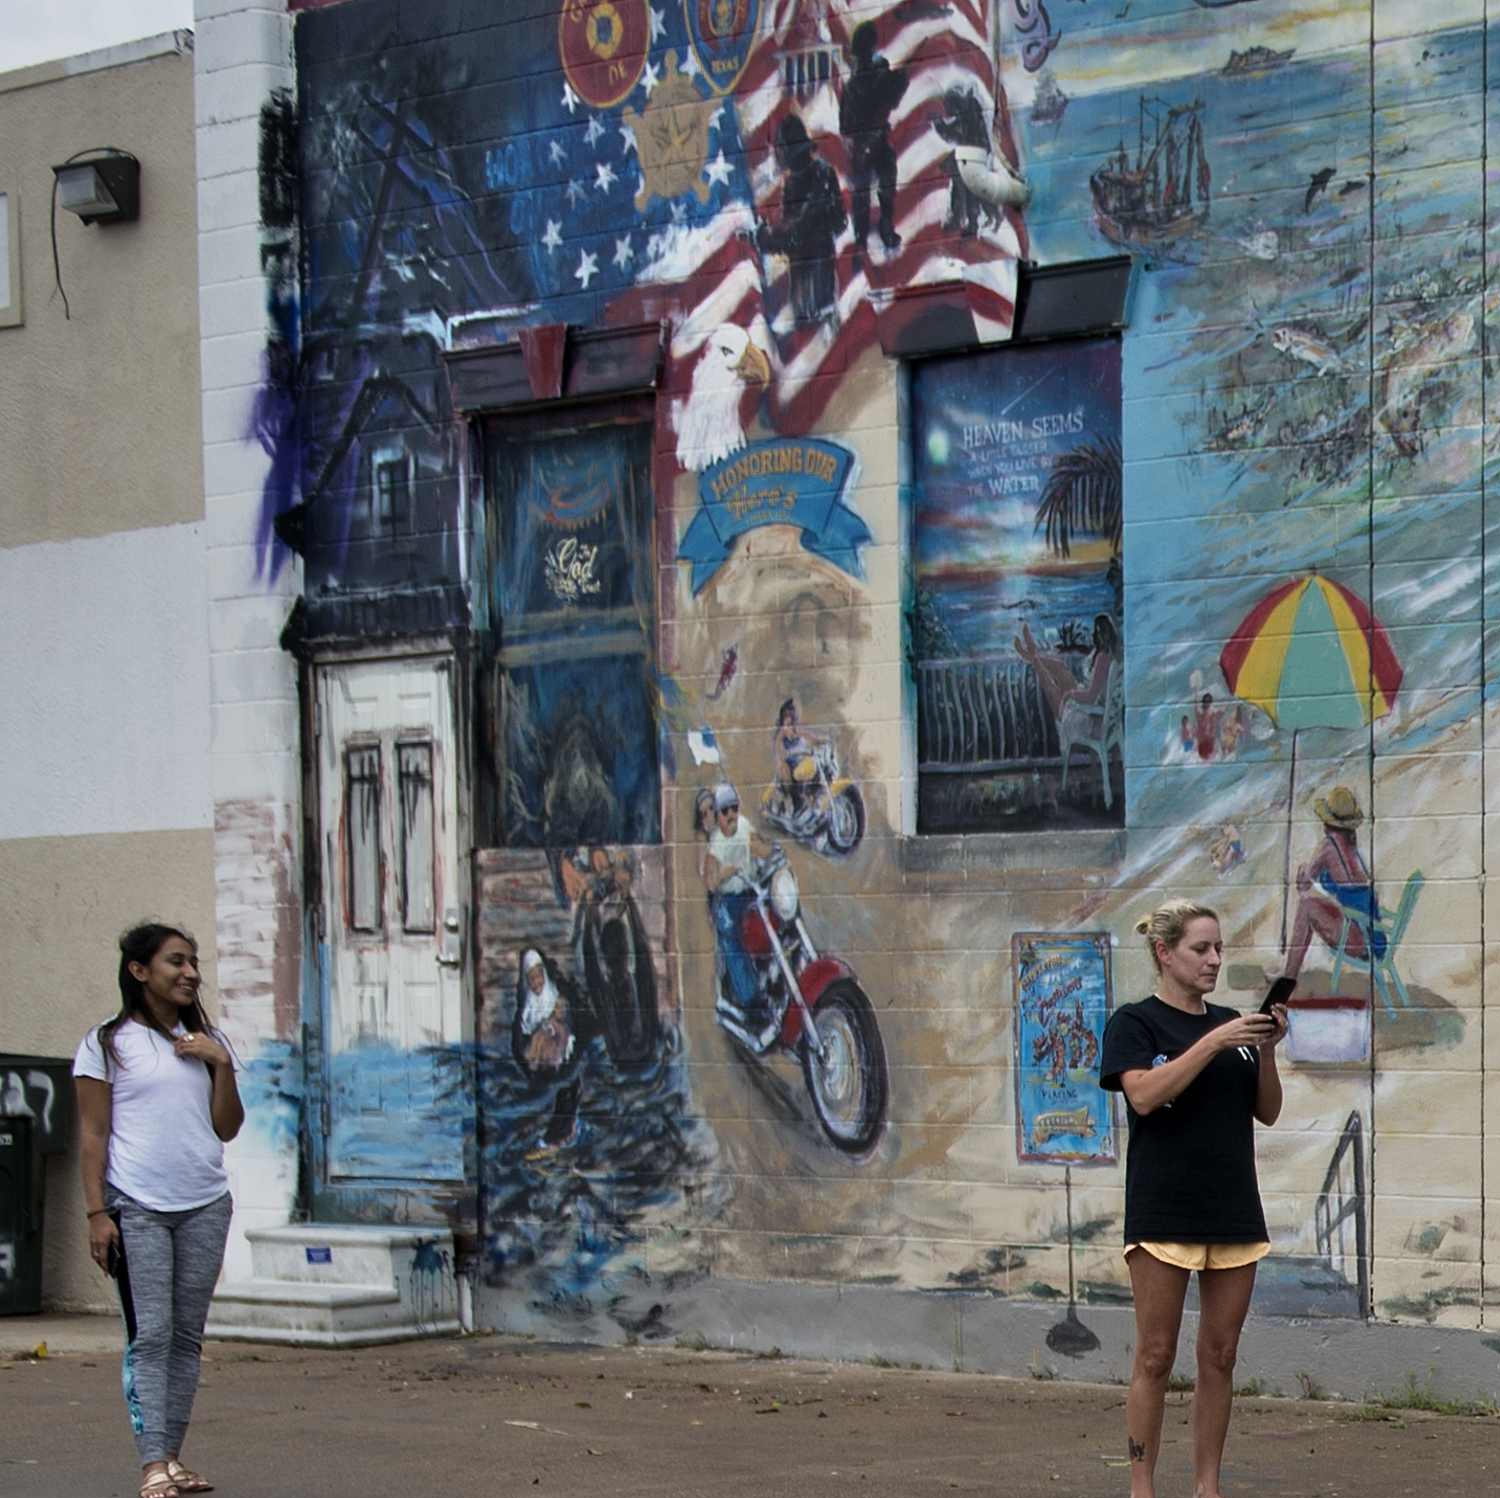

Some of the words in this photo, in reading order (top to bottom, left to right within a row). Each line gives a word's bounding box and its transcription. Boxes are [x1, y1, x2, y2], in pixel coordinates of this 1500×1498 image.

[963, 420, 1024, 450] HEAVEN
[1032, 410, 1084, 438] SEEMS
[710, 447, 802, 498] HONORING
[987, 475, 1040, 496] WATER
